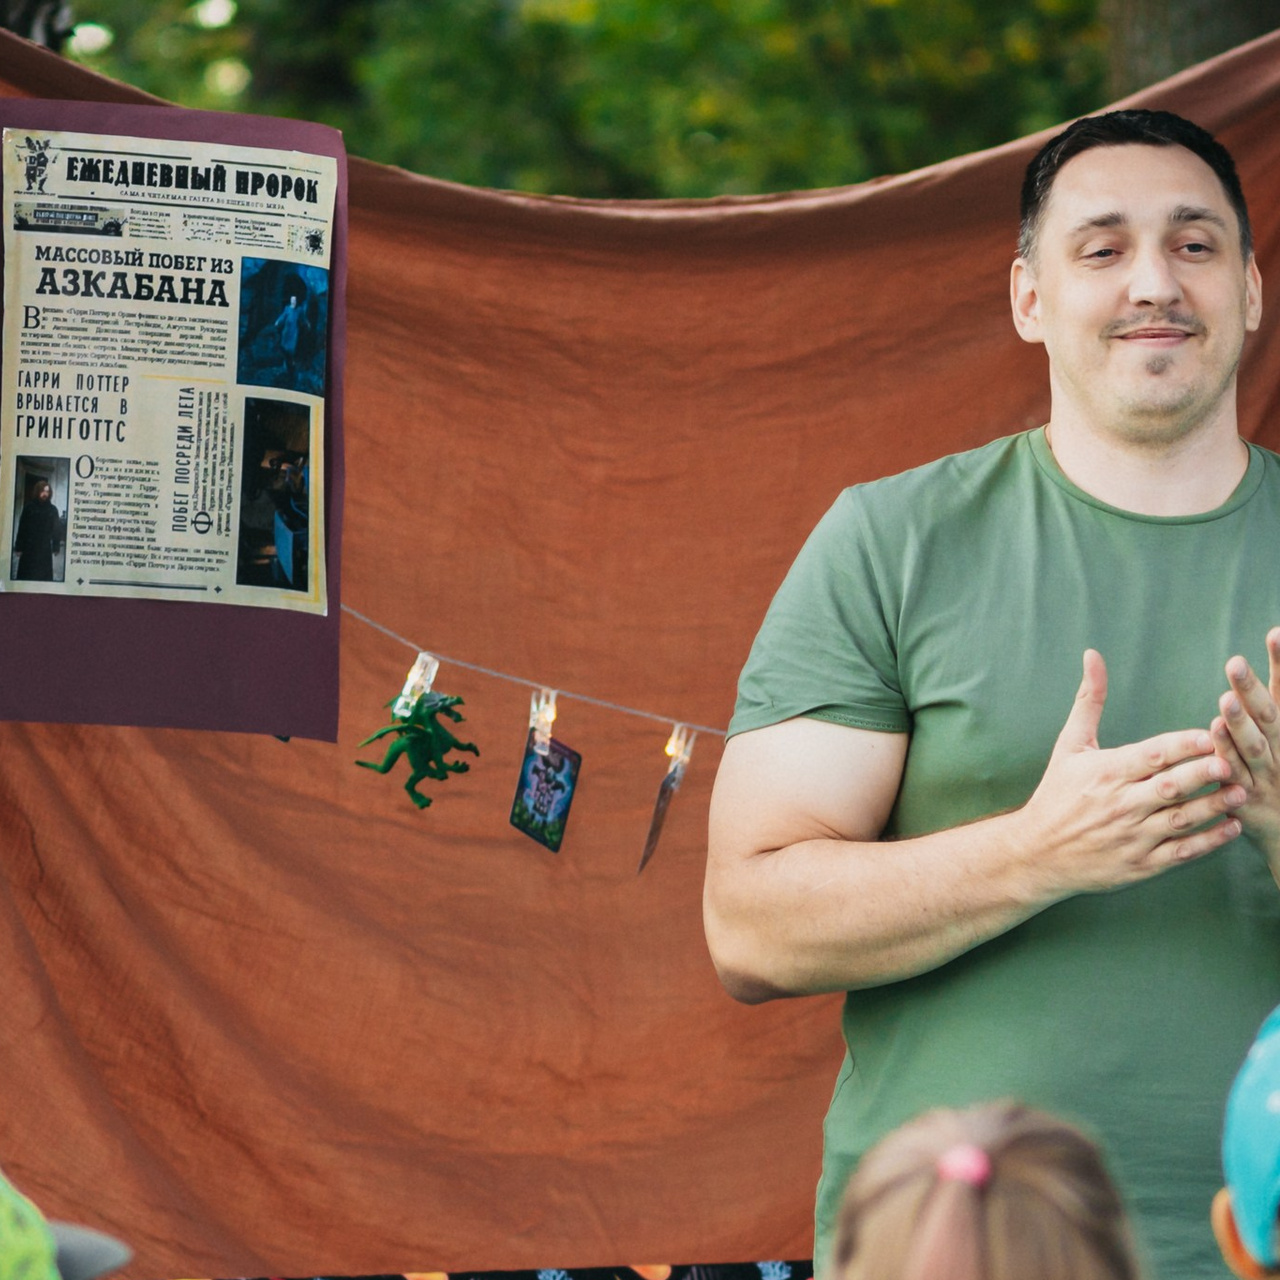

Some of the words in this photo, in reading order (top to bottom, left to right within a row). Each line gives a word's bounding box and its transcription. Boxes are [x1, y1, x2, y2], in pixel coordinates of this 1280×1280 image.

[66, 156, 227, 193] ЕЖЕДНЕВНЫЙ
[235, 170, 318, 204] ПРОРОК
[35, 245, 145, 267] МАССОВЫЙ
[149, 253, 207, 273] ПОБЕГ
[211, 258, 234, 275] ИЗ
[36, 267, 230, 308] АЗКАБАНА
[18, 370, 60, 389] ГАРРИ
[76, 373, 129, 393] ПОТТЕР
[17, 392, 98, 413] ВРЫВАЕТСЯ
[120, 398, 128, 415] В
[177, 387, 195, 419] ЛЕТА
[16, 415, 126, 442] ГРИНГОТТС
[174, 425, 194, 484] ПОСРЕДИ
[172, 491, 189, 533] ПОБЕГ
